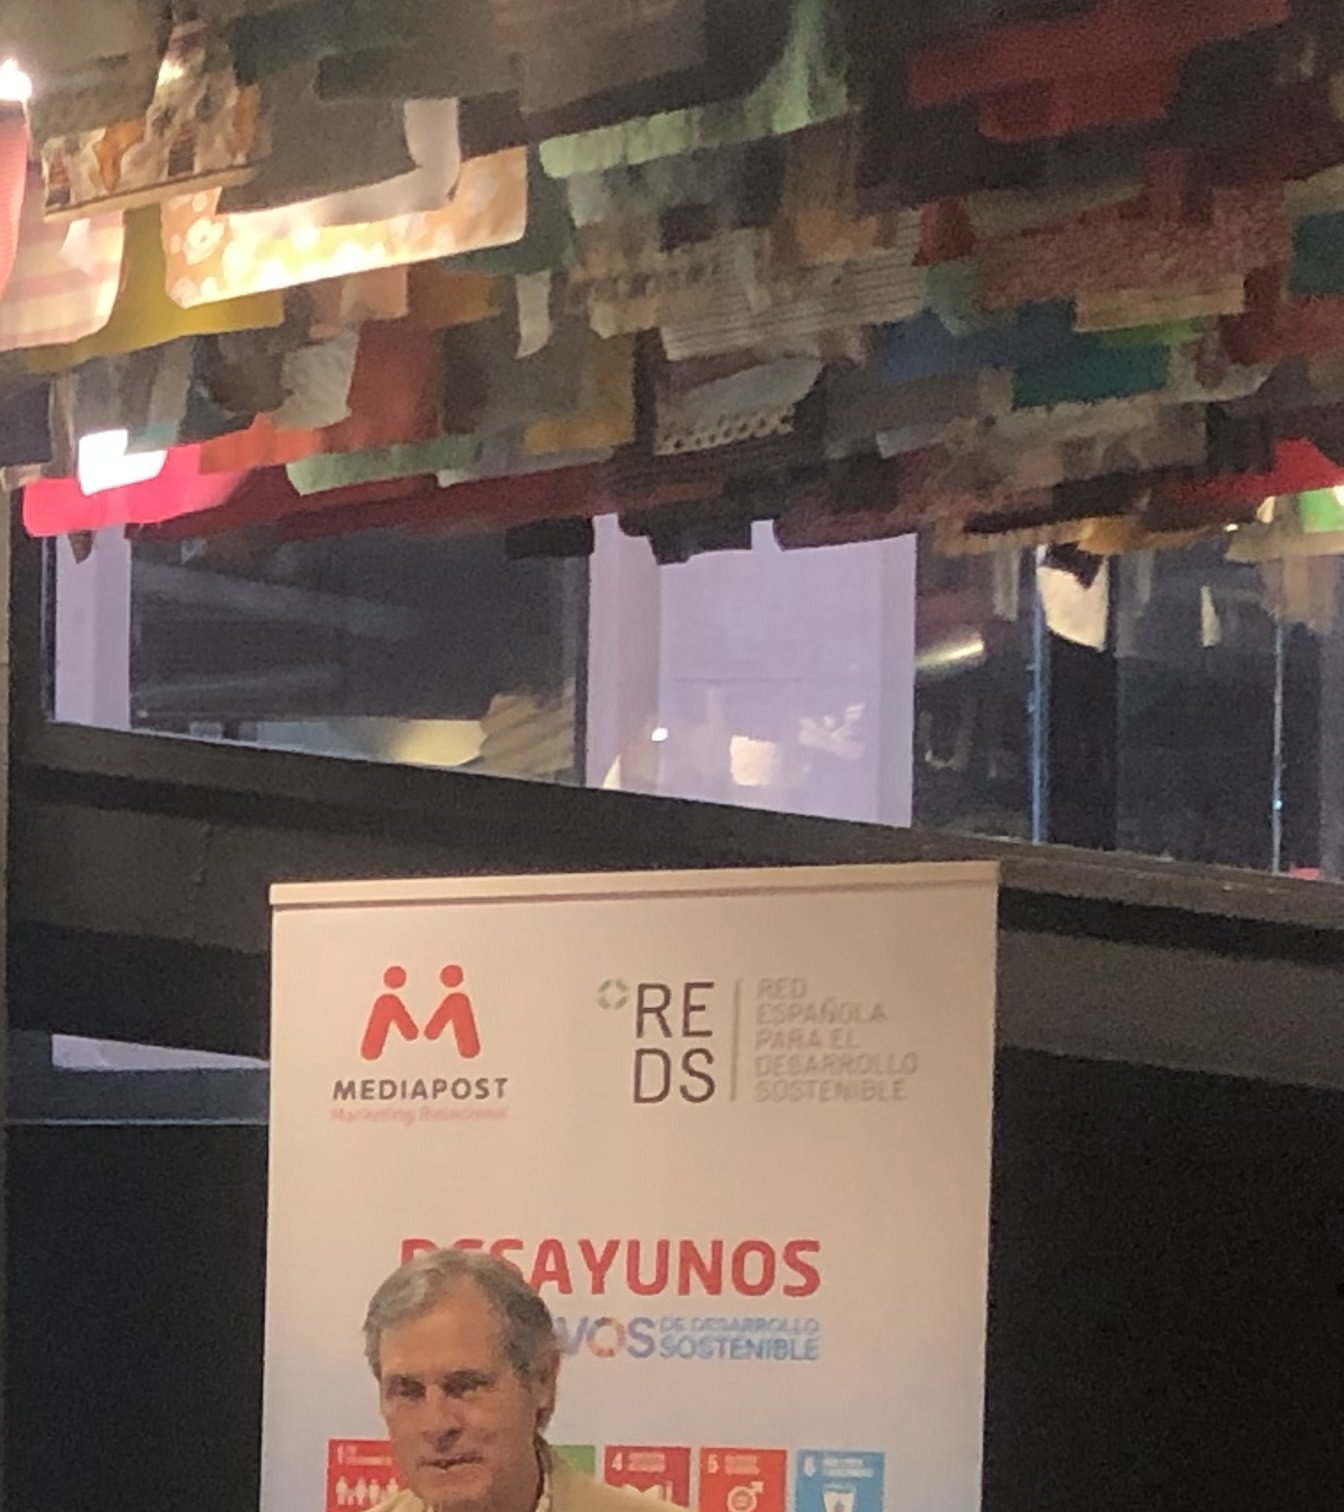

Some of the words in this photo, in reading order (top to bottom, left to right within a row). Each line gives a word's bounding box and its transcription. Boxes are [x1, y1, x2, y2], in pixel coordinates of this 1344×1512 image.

[757, 977, 808, 999] RED
[635, 981, 715, 1038] RE
[755, 1027, 823, 1050] PARA
[829, 1027, 860, 1048] EL
[632, 1047, 716, 1104] DS
[754, 1051, 919, 1076] DESARROLLO
[332, 1077, 509, 1101] MEDIAPOST
[754, 1078, 908, 1102] SOSTENIBLE
[659, 1335, 820, 1361] SOSTENIBLE
[611, 1452, 623, 1472] 4
[707, 1453, 718, 1474] 5
